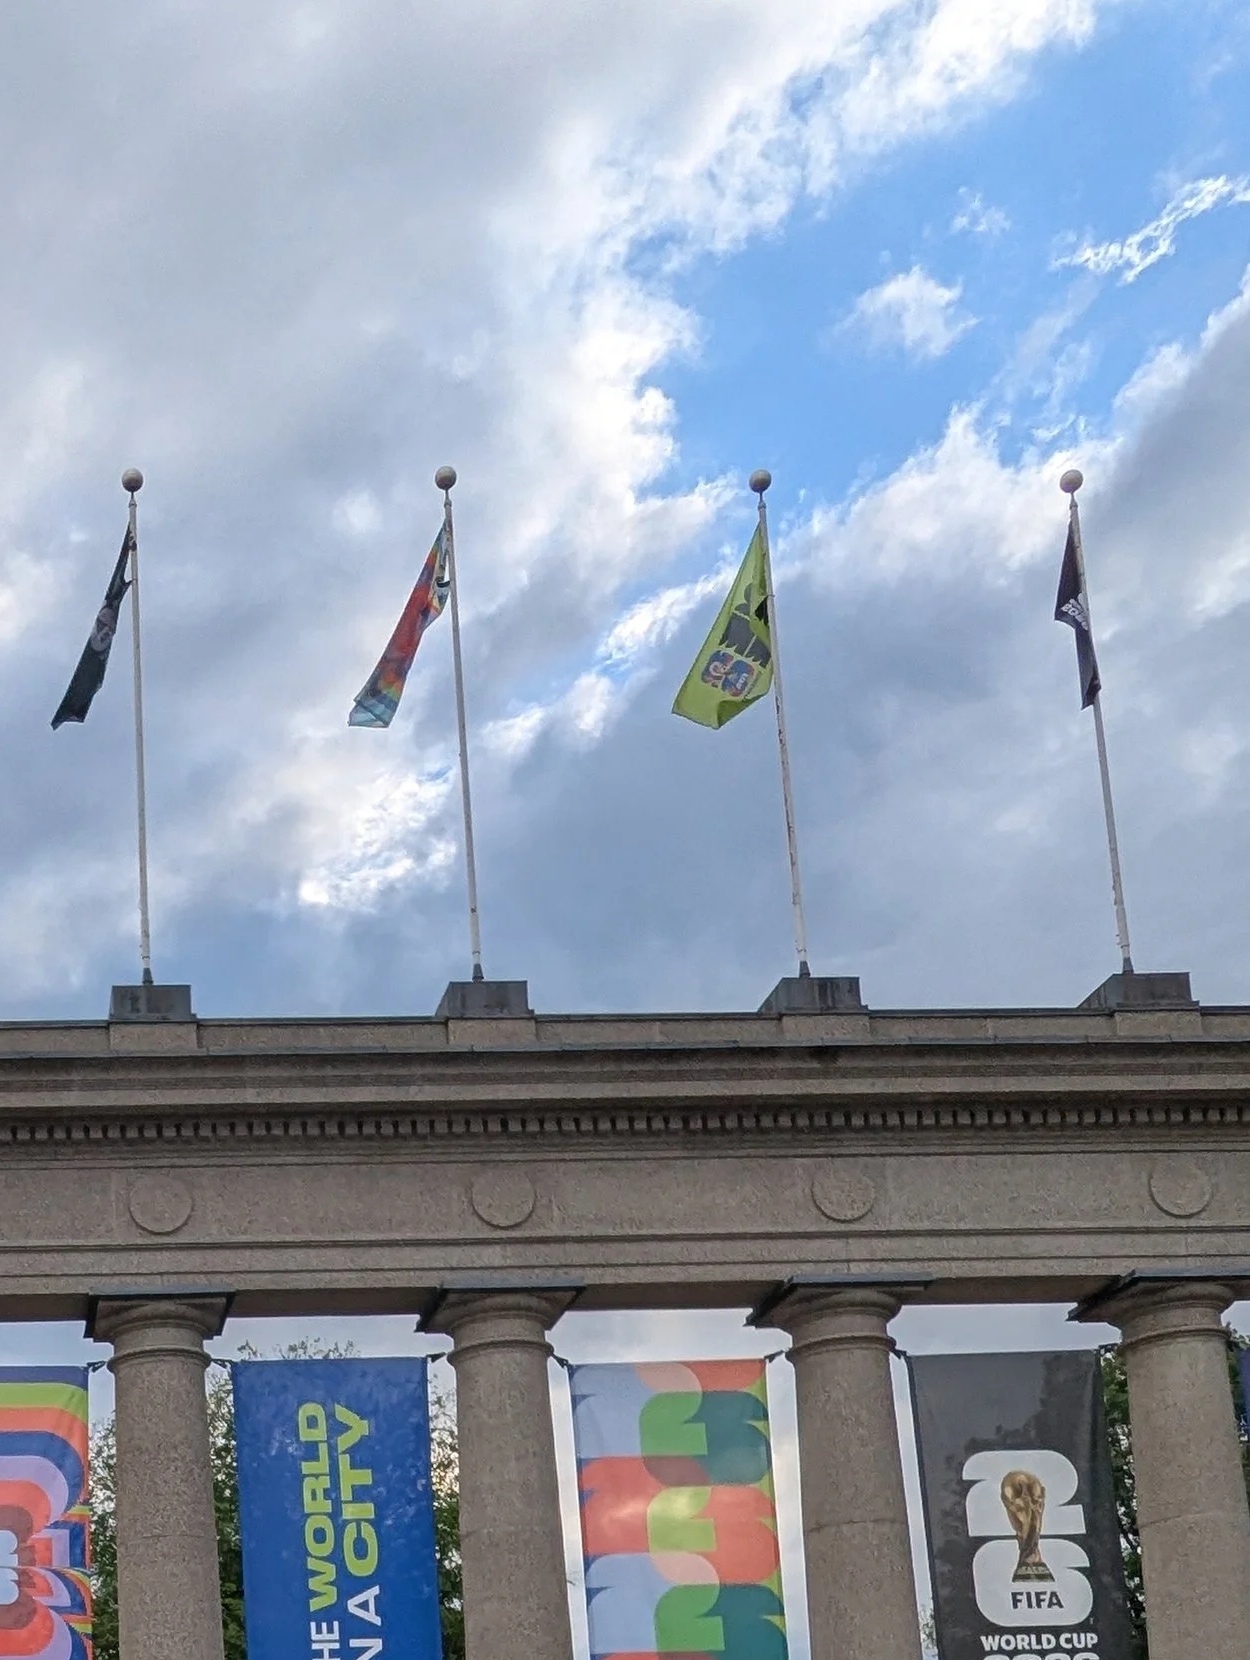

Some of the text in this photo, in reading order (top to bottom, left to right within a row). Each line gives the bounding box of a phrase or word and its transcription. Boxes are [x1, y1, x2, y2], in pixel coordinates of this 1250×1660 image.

[299, 1402, 337, 1612] WORLD
[335, 1402, 378, 1577] CITY
[347, 1585, 382, 1627] A
[1011, 1591, 1064, 1610] FIFA
[980, 1632, 1098, 1651] WORLD CUP
